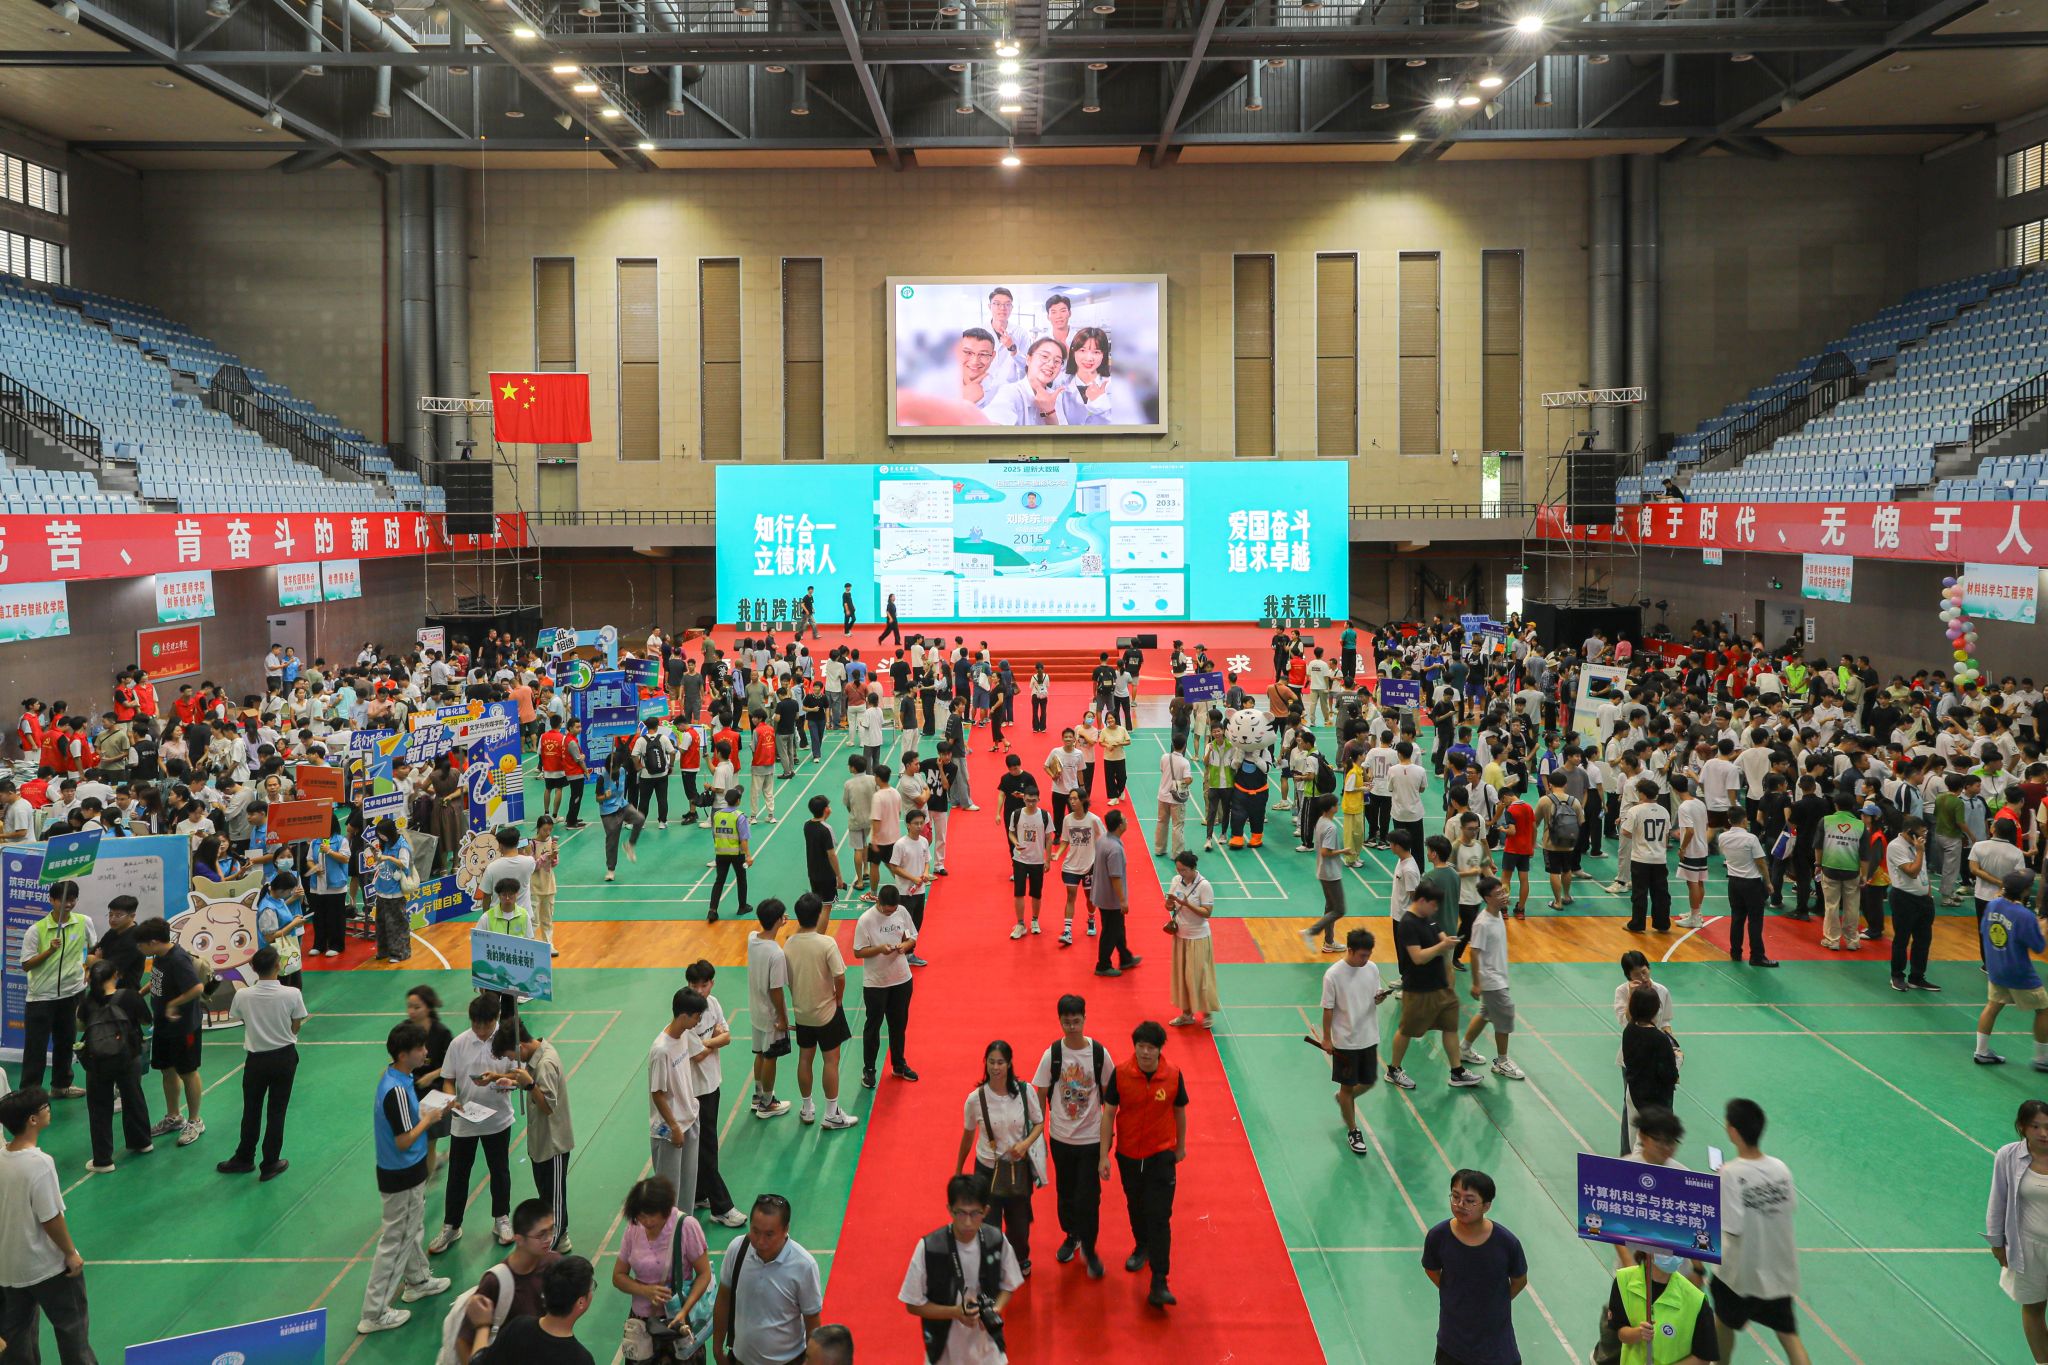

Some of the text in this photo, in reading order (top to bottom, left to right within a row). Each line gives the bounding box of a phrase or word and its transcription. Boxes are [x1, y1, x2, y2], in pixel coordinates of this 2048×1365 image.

[753, 513, 837, 544] 知行合一
[1227, 509, 1311, 541] 爱国奋斗
[1013, 534, 1044, 545] 2015
[753, 543, 837, 576] 立德树人
[1227, 540, 1311, 573] 追求卓越
[1967, 582, 2034, 601] 材料科学与工程学院
[1271, 618, 1320, 629] 2025
[413, 725, 444, 747] 你好
[405, 739, 453, 764] 新同学
[1643, 818, 1666, 842] 07
[1583, 1183, 1716, 1218] 计算机科学与技术学院
